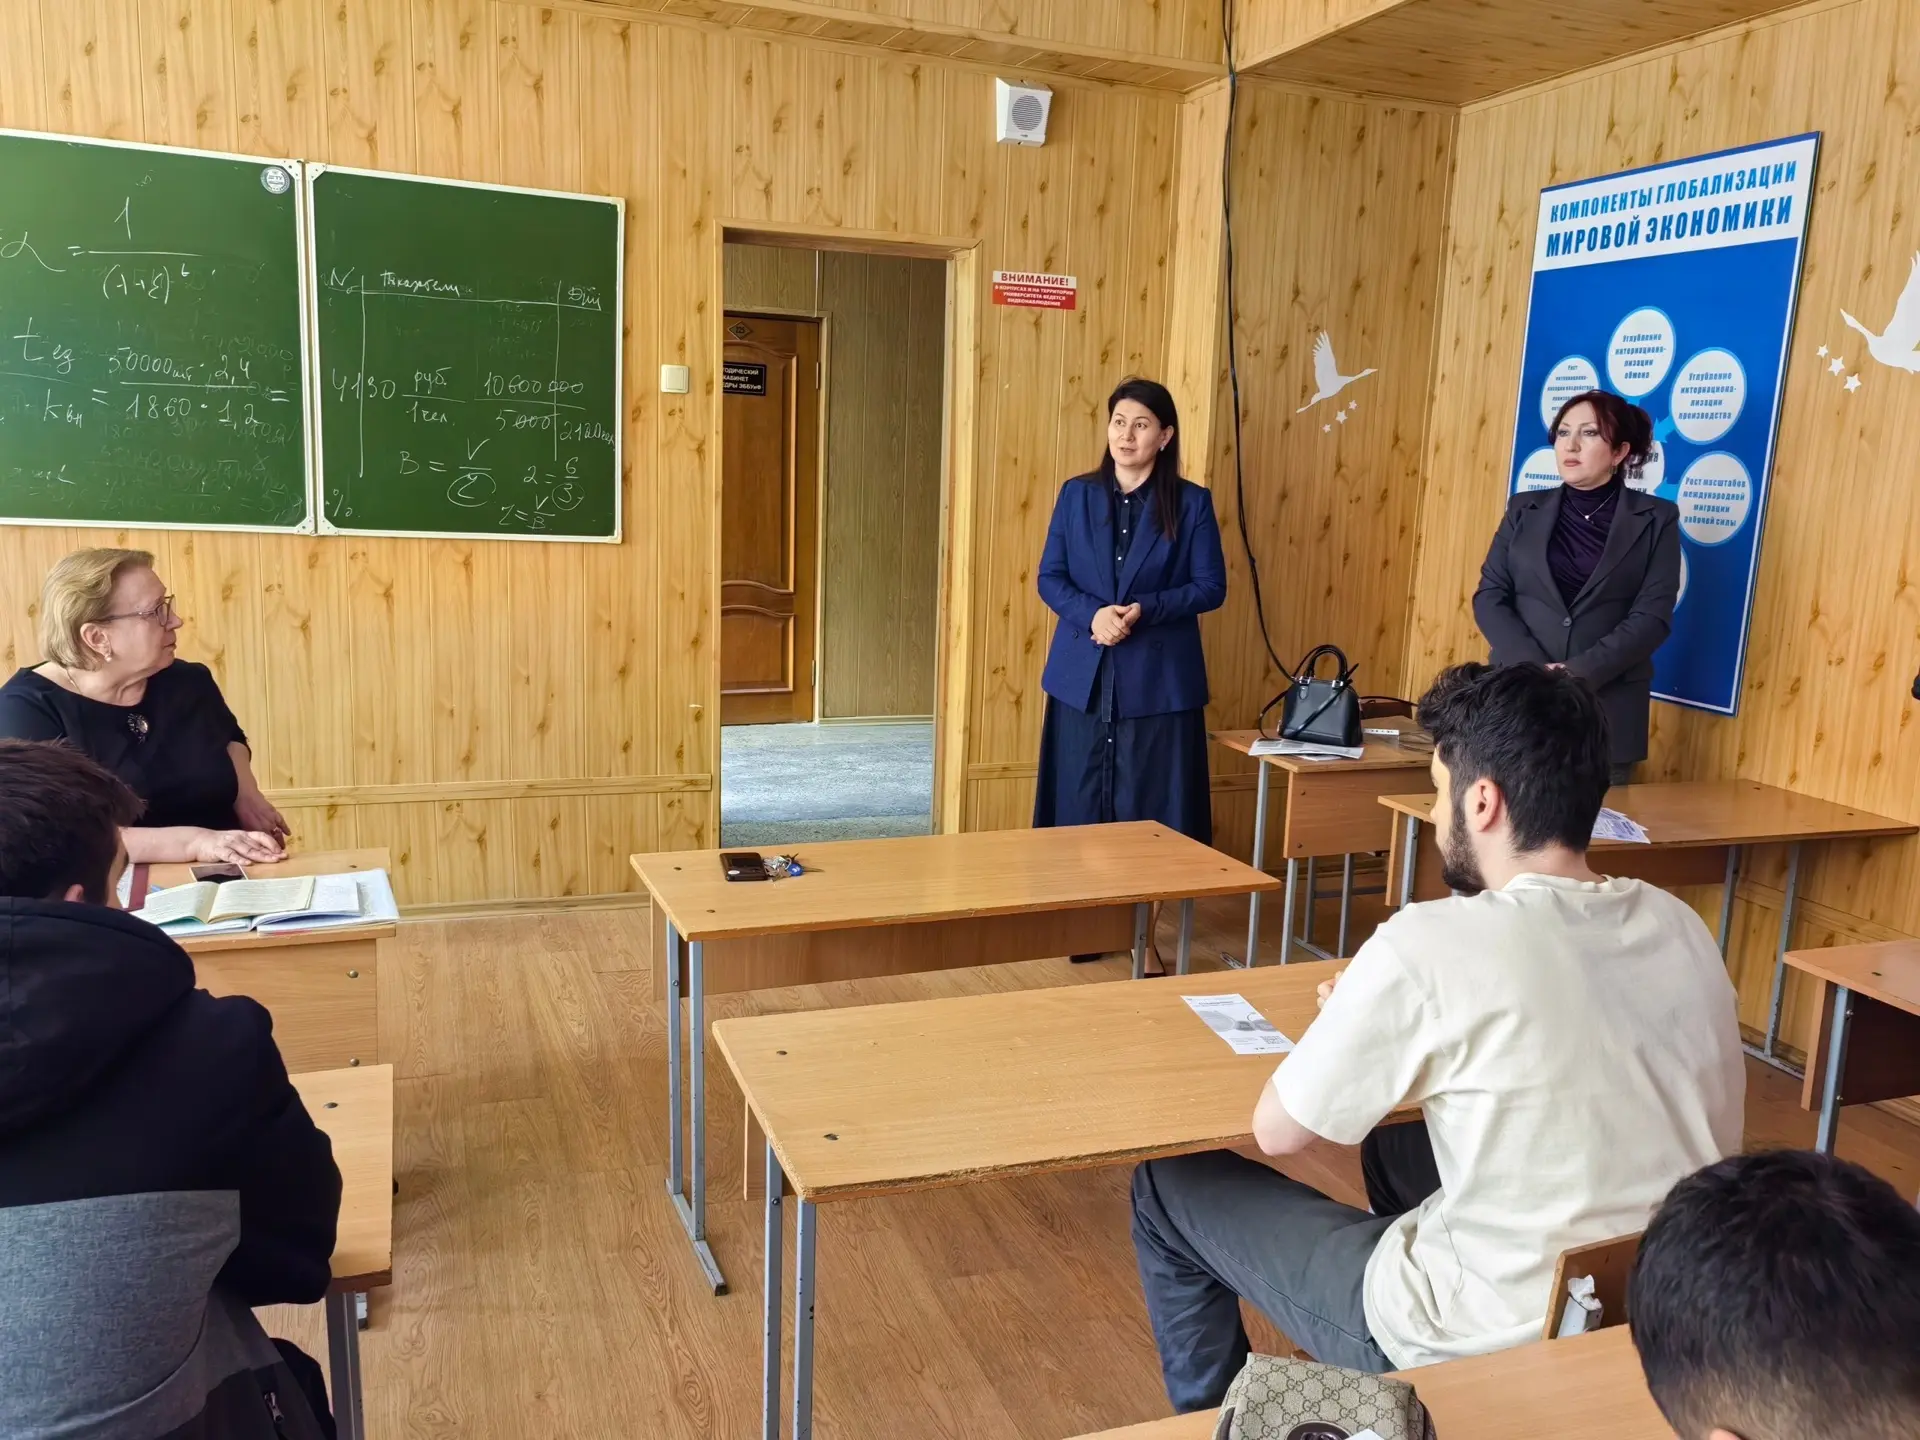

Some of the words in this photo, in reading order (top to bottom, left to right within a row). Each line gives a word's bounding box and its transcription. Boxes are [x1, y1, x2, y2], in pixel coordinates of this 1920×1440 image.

[1550, 187, 1652, 222] КОМПОНЕНТЫ
[1656, 161, 1797, 205] ГЛОБАЛИЗАЦИИ
[1546, 215, 1641, 257] МИРОВОЙ
[1645, 195, 1793, 242] ЭКОНОМИКИ
[1001, 273, 1069, 286] ВНИМАНИЕ!
[1689, 372, 1732, 381] Углубление
[1690, 399, 1723, 407] лизации
[1679, 412, 1732, 420] производства
[1685, 477, 1702, 486] Рост
[1703, 479, 1746, 488] масштабов
[1693, 504, 1730, 513] миграции
[1716, 519, 1736, 527] силы
